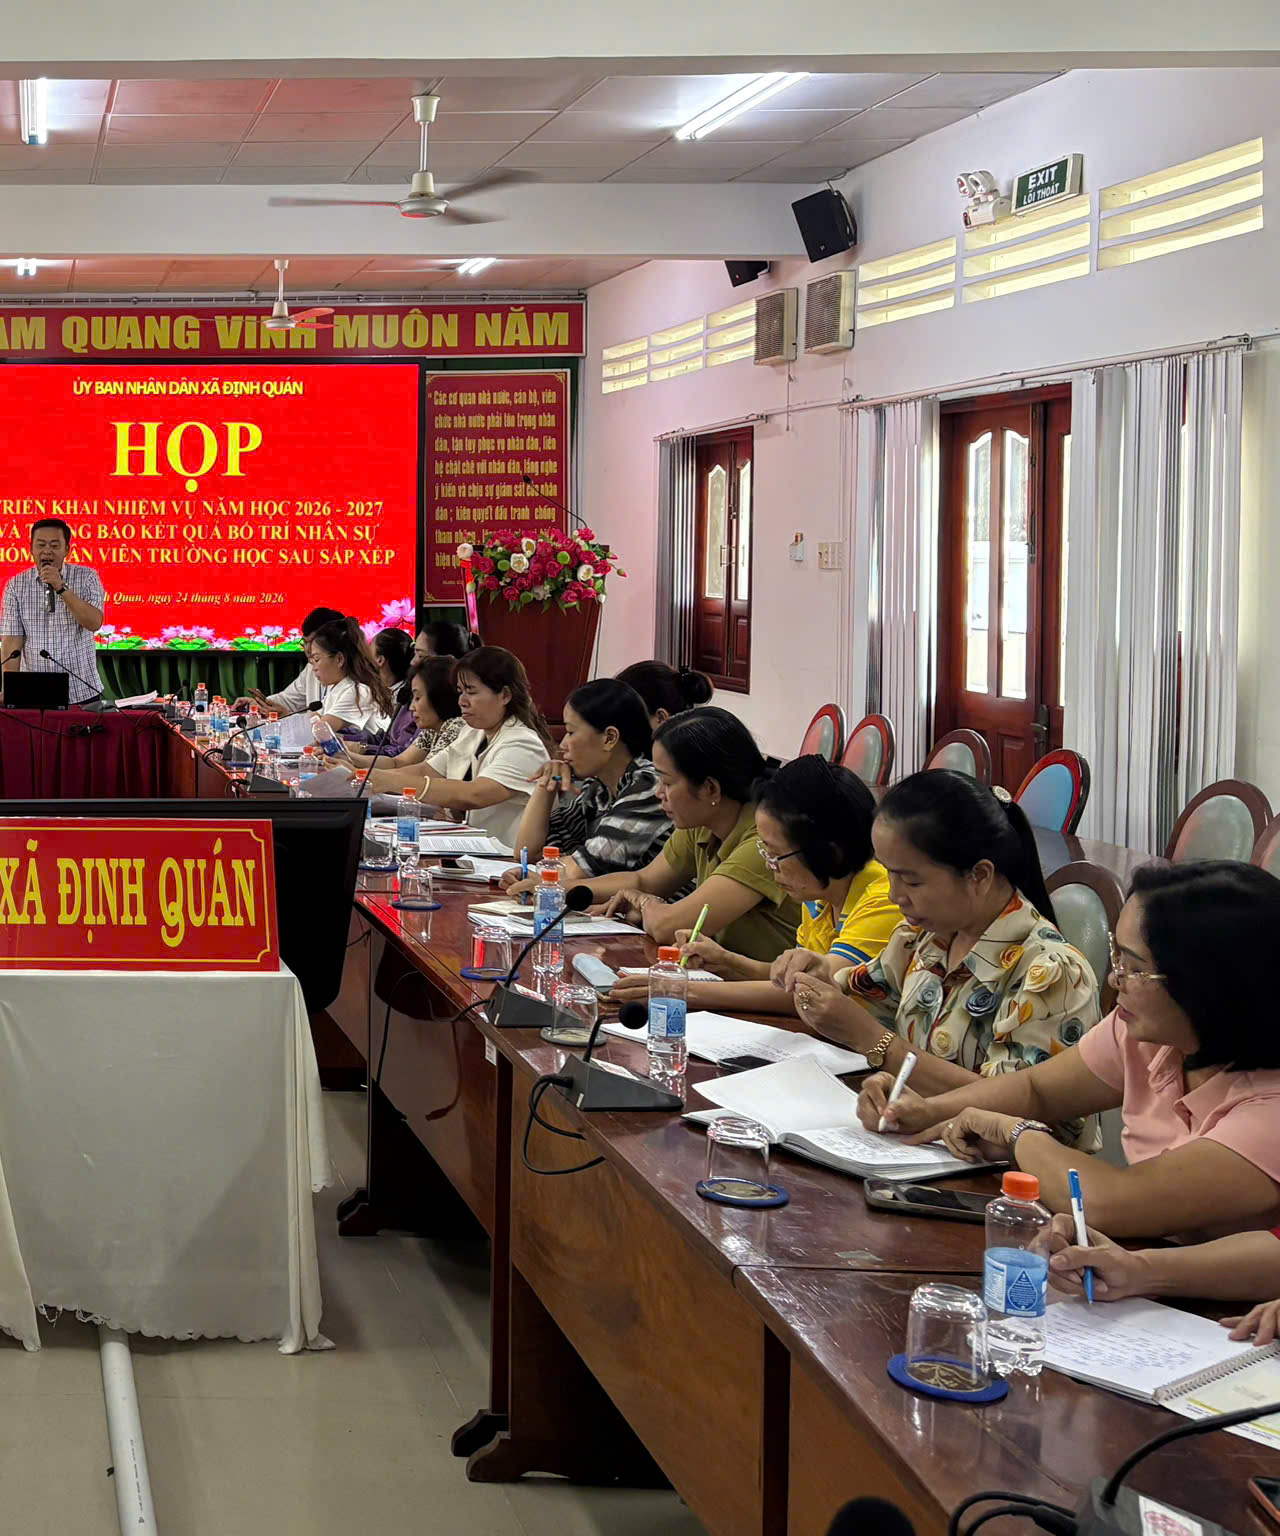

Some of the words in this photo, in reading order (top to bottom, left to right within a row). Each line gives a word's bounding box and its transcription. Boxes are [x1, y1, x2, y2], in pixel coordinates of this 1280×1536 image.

[1028, 166, 1058, 190] EXIT
[1037, 182, 1060, 201] THOÁT
[61, 315, 200, 354] QUANG
[215, 315, 317, 349] VINH
[333, 308, 458, 348] MUÔN
[475, 306, 569, 346] NĂM
[72, 377, 93, 396] ỦY
[95, 381, 124, 396] BAN
[126, 377, 167, 395] NHÂN
[169, 377, 200, 395] DÂN
[201, 377, 220, 395] XÃ
[222, 381, 261, 398] ĐỊNH
[262, 377, 304, 398] QUÁN
[449, 391, 457, 405] cơ
[459, 391, 476, 407] quan
[478, 389, 490, 405] nhà
[493, 390, 512, 405] nước,
[514, 389, 526, 404] cán
[529, 389, 539, 406] bộ,
[542, 389, 556, 404] viên
[435, 414, 451, 428] chức
[454, 414, 466, 428] nhà
[468, 414, 485, 428] nước
[487, 412, 502, 429] phải
[504, 413, 515, 427] tôn
[517, 413, 536, 430] trọng
[539, 412, 555, 427] nhân
[435, 438, 449, 453] dân,
[452, 437, 463, 454] tận
[478, 437, 494, 454] phục
[497, 438, 505, 453] vụ
[508, 436, 523, 450] nhân
[526, 436, 541, 452] dân,
[543, 436, 556, 450] liên
[109, 421, 263, 493] HỌP
[435, 460, 443, 477] hệ
[445, 460, 460, 477] chặt
[488, 460, 505, 473] nhân
[508, 460, 522, 475] dân,
[524, 458, 538, 476] lắng
[541, 460, 557, 476] nghe
[441, 483, 456, 497] kiến
[458, 484, 466, 497] và
[468, 484, 483, 499] chịu
[485, 484, 493, 499] sự
[496, 483, 512, 499] giám
[514, 483, 525, 497] sát
[541, 482, 557, 496] nhân
[52, 499, 99, 515] KHAI
[104, 497, 166, 519] NHIỆM
[171, 499, 197, 520] VỤ
[202, 497, 245, 516] NĂM
[250, 500, 290, 520] HỌC
[294, 501, 332, 516] 2026
[346, 501, 384, 516] 2027
[456, 506, 470, 520] kiên
[472, 505, 492, 522] quyết
[495, 506, 507, 520] đấu
[511, 506, 529, 520] tranh
[535, 506, 555, 522] chống
[27, 523, 92, 539] TNG
[97, 520, 136, 539] BÁO
[257, 521, 289, 540] TRÍ
[295, 520, 348, 540] NHÂN
[353, 523, 380, 544] SỰ
[436, 530, 452, 543] tham
[99, 544, 142, 563] VIÊN
[147, 543, 227, 564] TRƯỜNG
[233, 549, 274, 567] HỌC
[278, 549, 315, 564] SAU
[436, 552, 450, 569] hiện
[175, 591, 189, 603] 24
[224, 592, 230, 603] 8
[233, 592, 256, 603] năm
[259, 592, 285, 603] 2026
[56, 858, 147, 944] ĐỊNH
[158, 837, 256, 948] QUÁN
